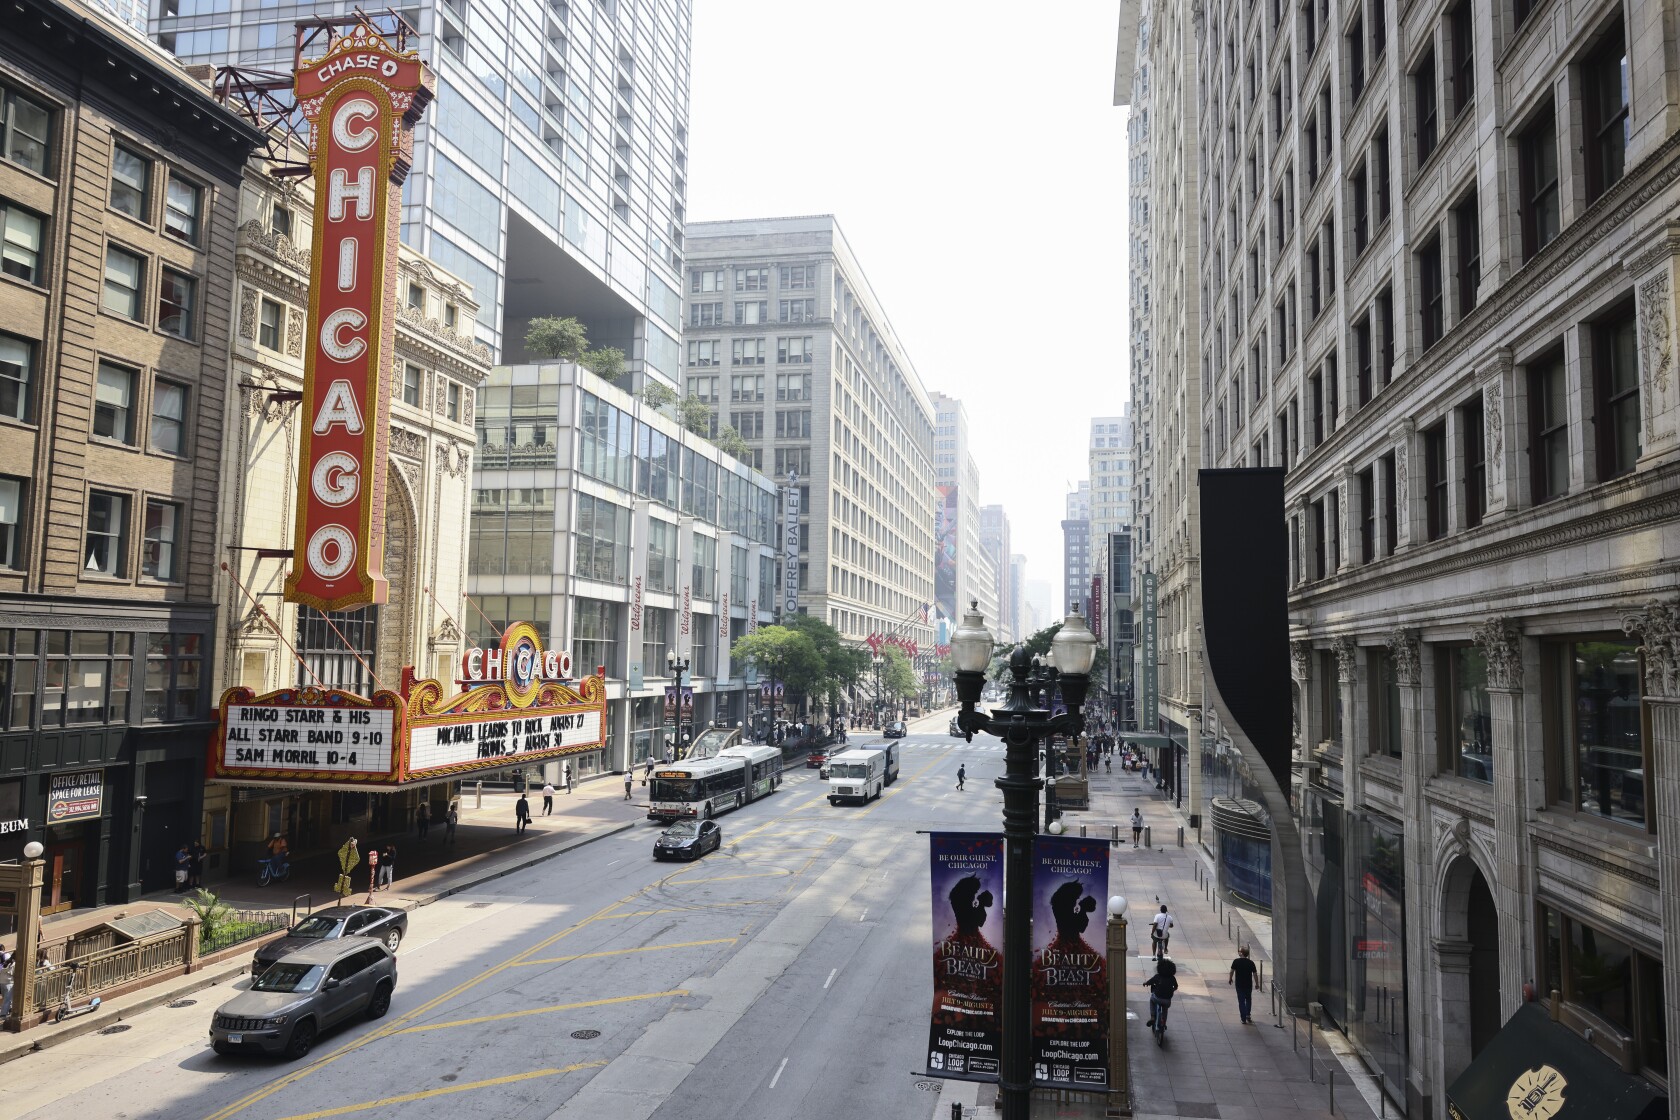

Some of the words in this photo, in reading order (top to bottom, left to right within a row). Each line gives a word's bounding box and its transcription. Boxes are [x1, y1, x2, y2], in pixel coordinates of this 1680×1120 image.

[317, 54, 380, 82] CHASE
[307, 98, 379, 580] CHICAGO
[788, 488, 798, 546] BALLET
[786, 550, 797, 612] OFFREY
[632, 576, 644, 631] Walgreens
[680, 586, 692, 635] Walgreens
[720, 592, 730, 638] Walgreens
[467, 647, 573, 680] CHICAGO
[240, 708, 278, 722] RINGO
[286, 709, 324, 723] STARR
[333, 710, 342, 723] &
[350, 711, 370, 724] HIS
[228, 728, 250, 742] ALL
[258, 729, 298, 743] STARR
[308, 730, 343, 744] BAND
[352, 732, 382, 745] 9-10
[437, 724, 474, 746] MICHAEL
[478, 721, 508, 741] LEARNS
[512, 720, 522, 736] TO
[525, 718, 542, 734] ROCK
[550, 714, 574, 733] AUGUST
[524, 733, 551, 752] AUGUST
[554, 732, 562, 747] 30
[236, 748, 264, 762] SAM
[272, 750, 319, 764] MORRIL
[327, 751, 356, 765] 10-4
[52, 772, 100, 788] OFFICE/RETAIL
[52, 789, 69, 800] SPACE
[71, 788, 82, 798] FOR
[83, 785, 100, 796] LEASE
[1050, 866, 1092, 874] CHICAGO!
[941, 940, 997, 964] BEAUTY
[1041, 948, 1100, 970] BEAUTY
[940, 958, 998, 980] BEAST
[1039, 966, 1100, 985] BEAST
[938, 1037, 993, 1051] LoopChicago.com
[1042, 1049, 1098, 1061] LoopChicago.com
